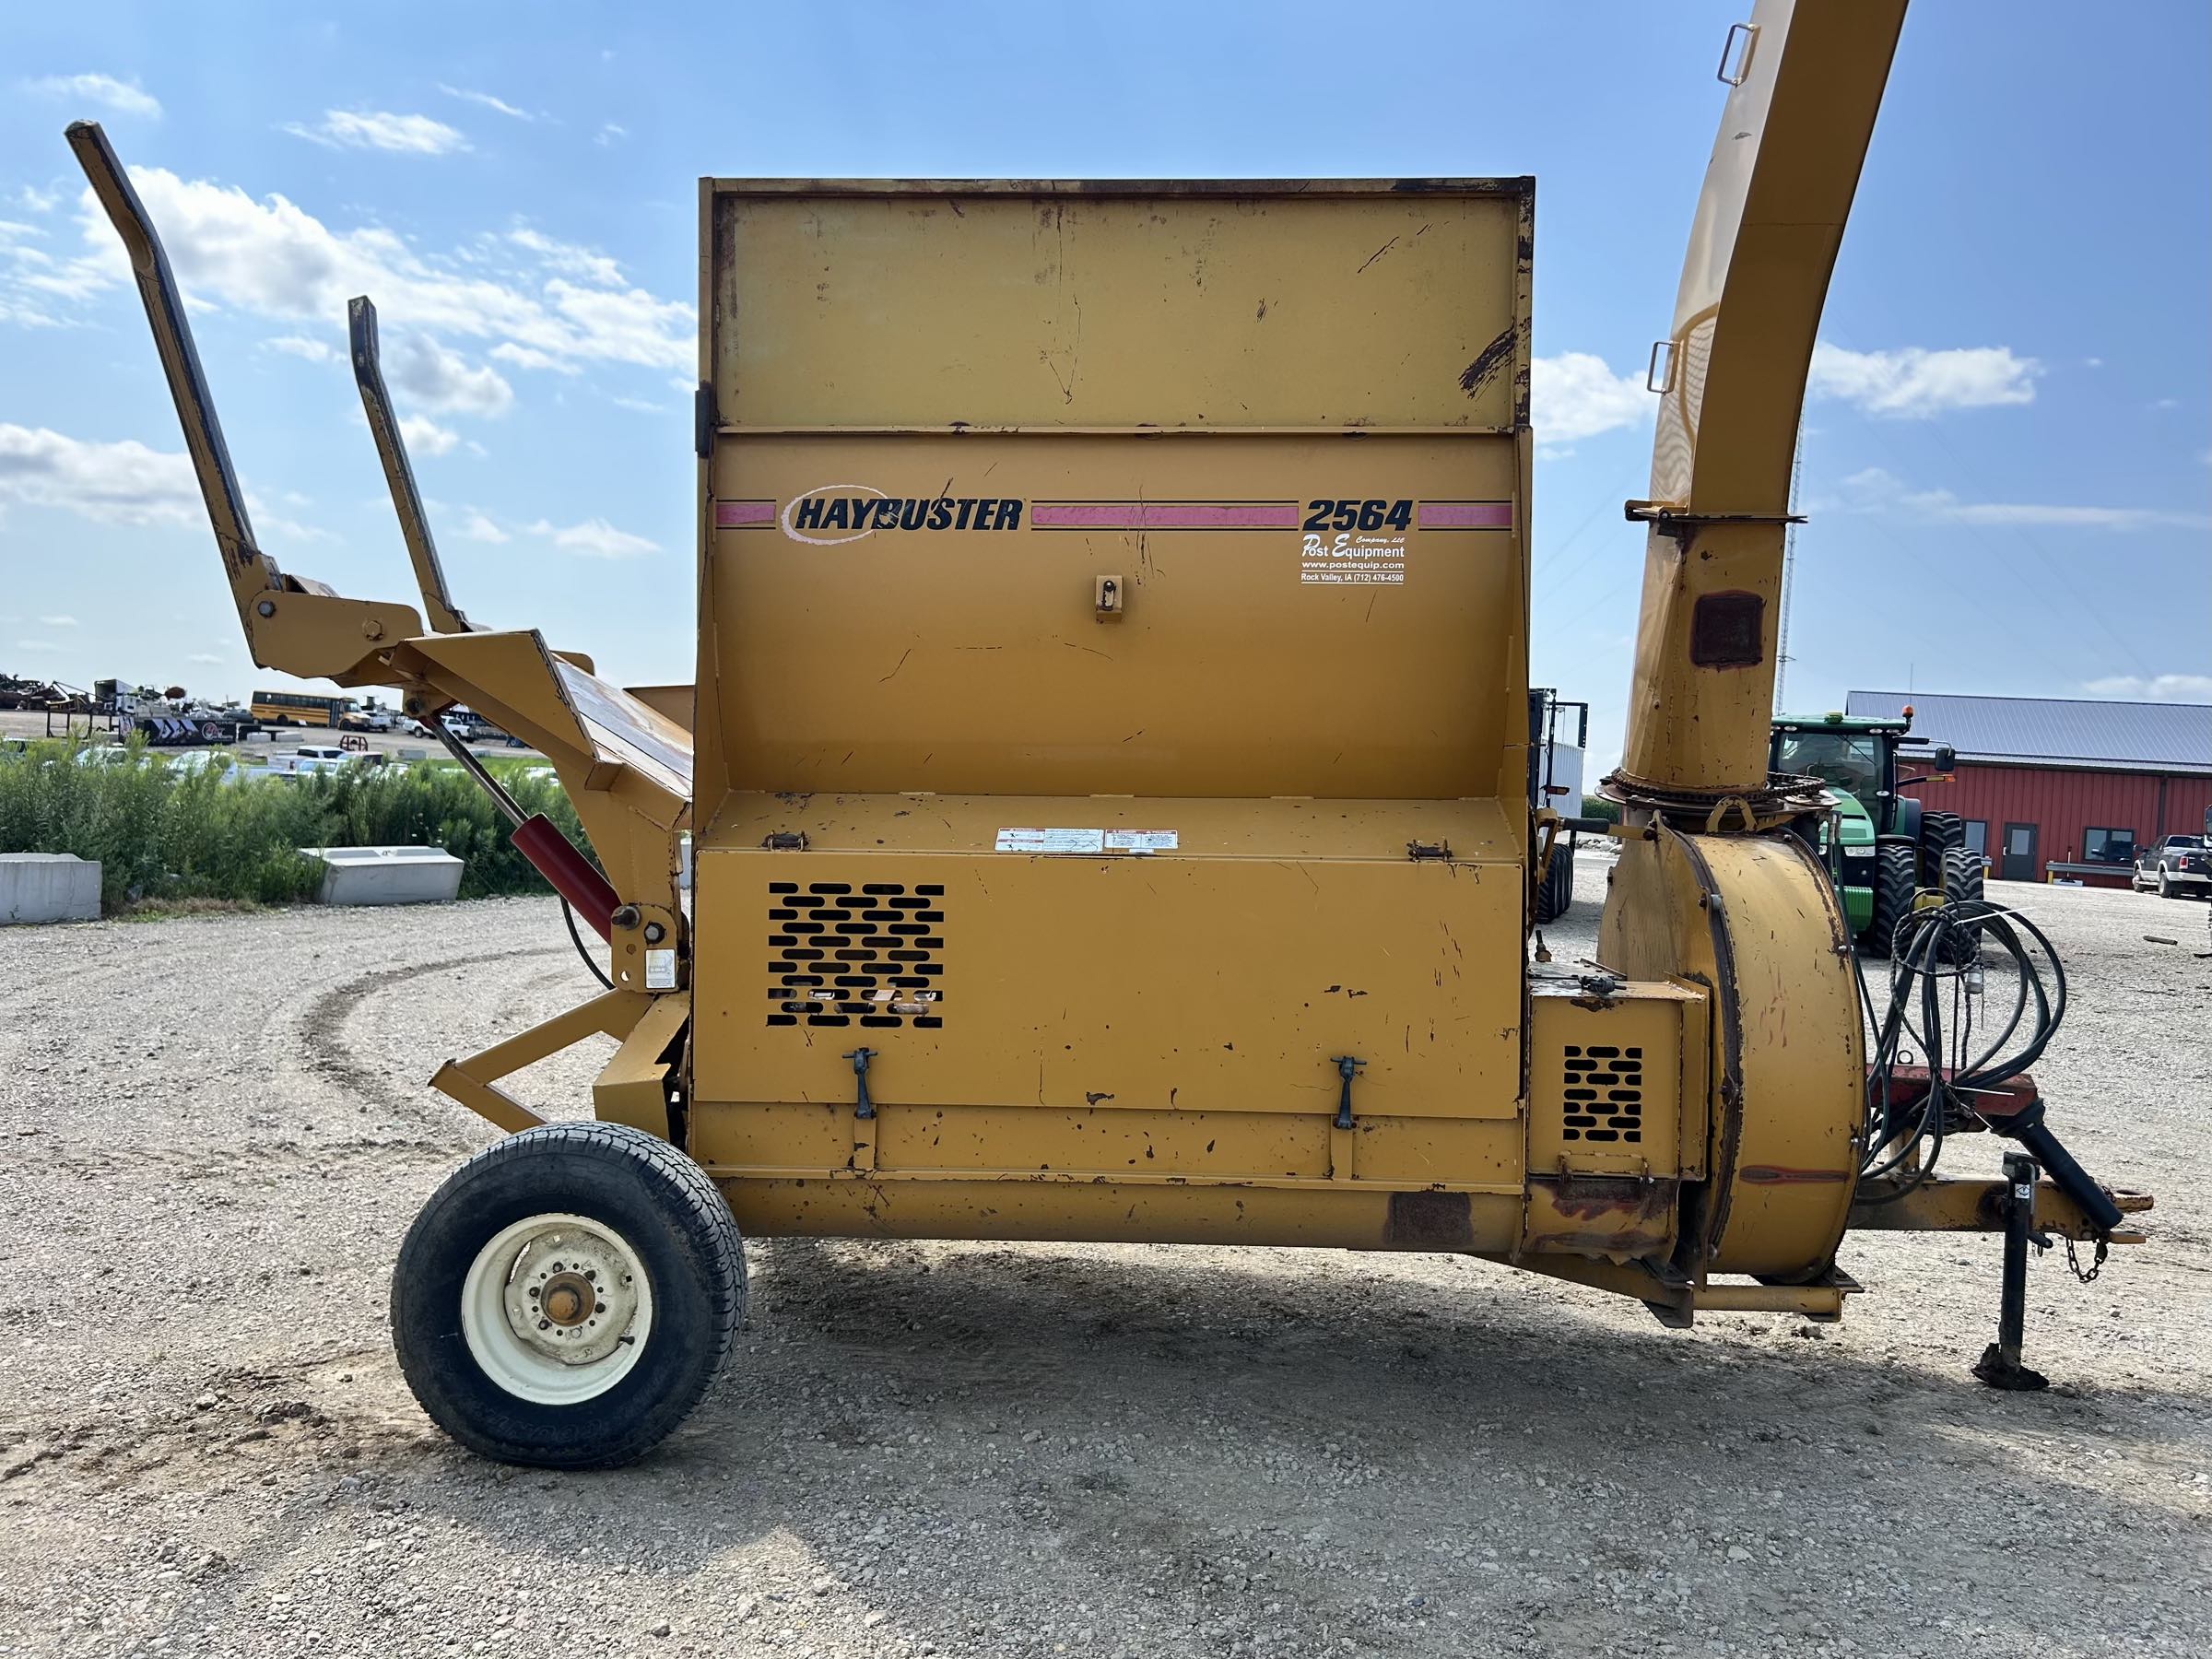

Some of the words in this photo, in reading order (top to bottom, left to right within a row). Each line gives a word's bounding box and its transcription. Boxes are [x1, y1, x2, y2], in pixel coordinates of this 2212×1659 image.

[795, 499, 1023, 530] HAYBUSTER
[1302, 500, 1413, 531] 2564
[1302, 534, 1328, 557] Post
[1332, 534, 1405, 559] Equipment
[1300, 573, 1319, 582] Rock
[1320, 573, 1343, 582] Valley,
[1353, 573, 1371, 582] (712)
[1372, 573, 1404, 582] 476-4500
